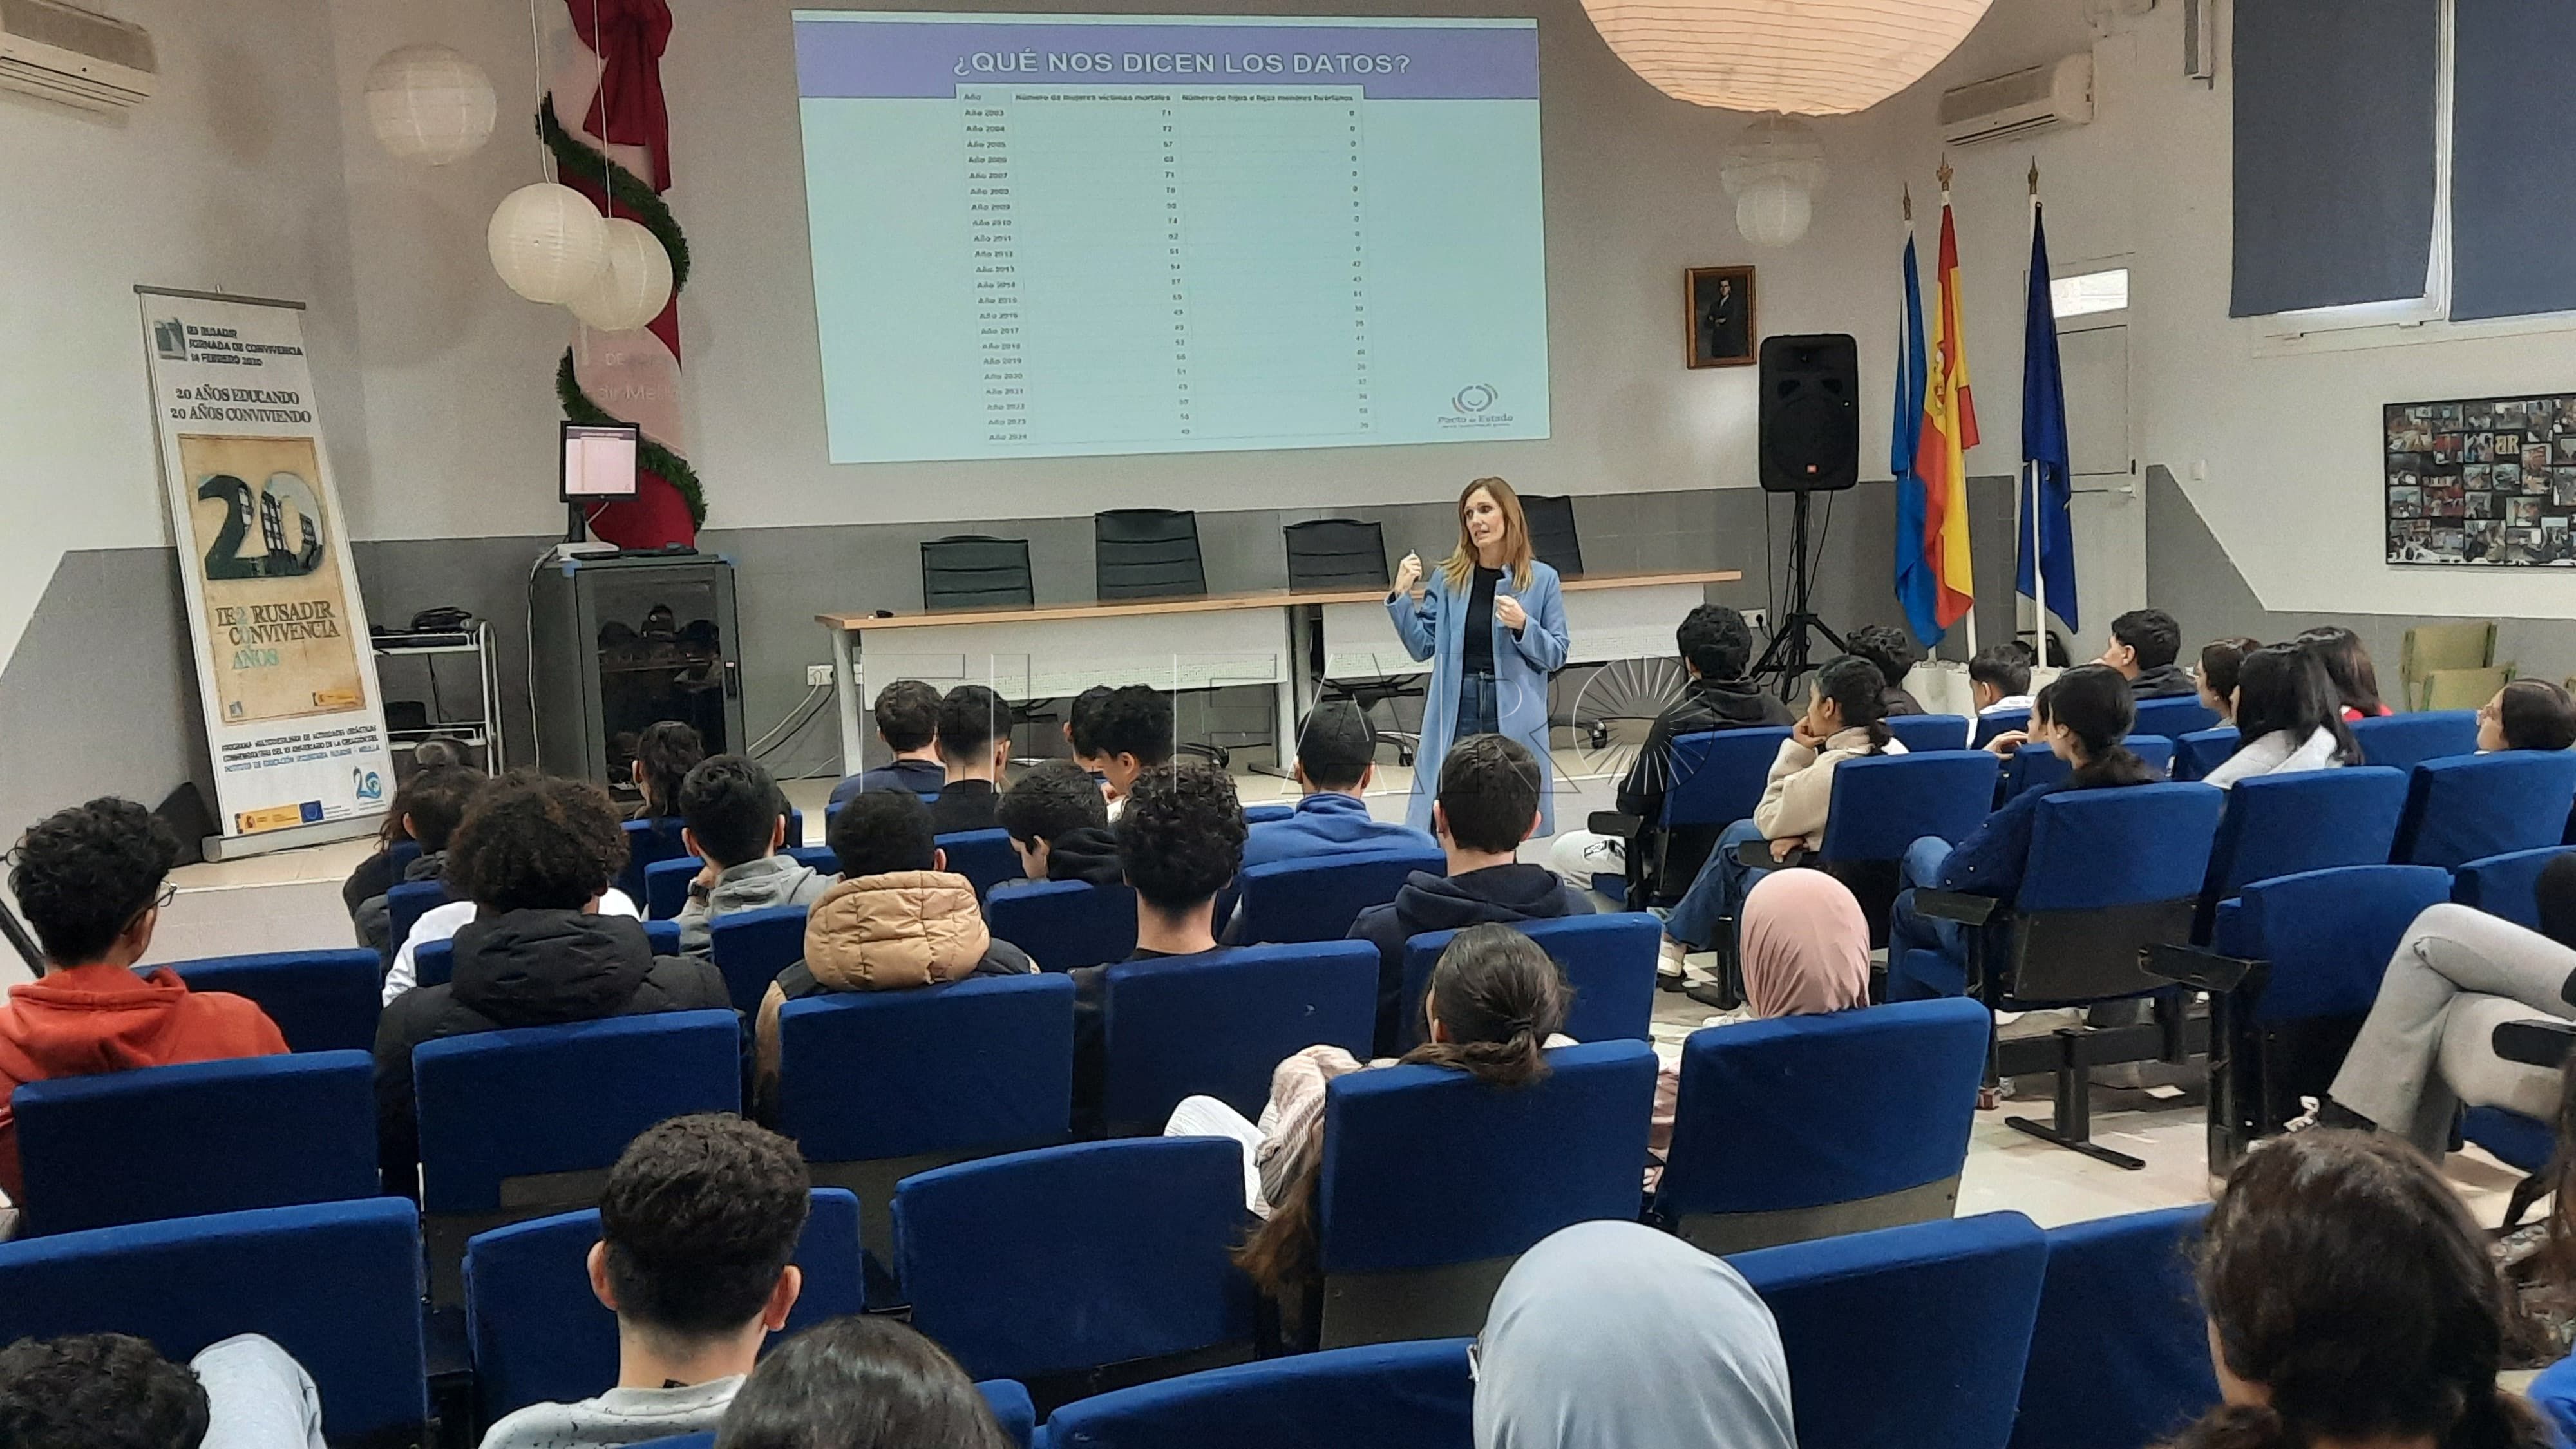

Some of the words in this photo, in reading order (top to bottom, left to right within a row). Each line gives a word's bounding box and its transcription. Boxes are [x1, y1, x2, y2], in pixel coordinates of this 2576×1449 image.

[953, 48, 1039, 77] ¿QUÉ
[1047, 52, 1114, 73] NOS
[1122, 53, 1215, 73] DICEN
[1224, 53, 1285, 74] LOS
[1293, 53, 1411, 74] DATOS?
[232, 342, 244, 352] DE
[175, 388, 192, 400] 20
[195, 384, 230, 402] AÑOS
[232, 388, 300, 405] EDUCANDO
[169, 407, 186, 419] 20
[189, 403, 224, 421] AÑOS
[225, 407, 312, 424] CONVIVIENDO
[1478, 413, 1514, 423] Estado
[198, 471, 325, 580] 20
[250, 600, 336, 624] RUSADIR
[232, 645, 280, 670] AÑOS
